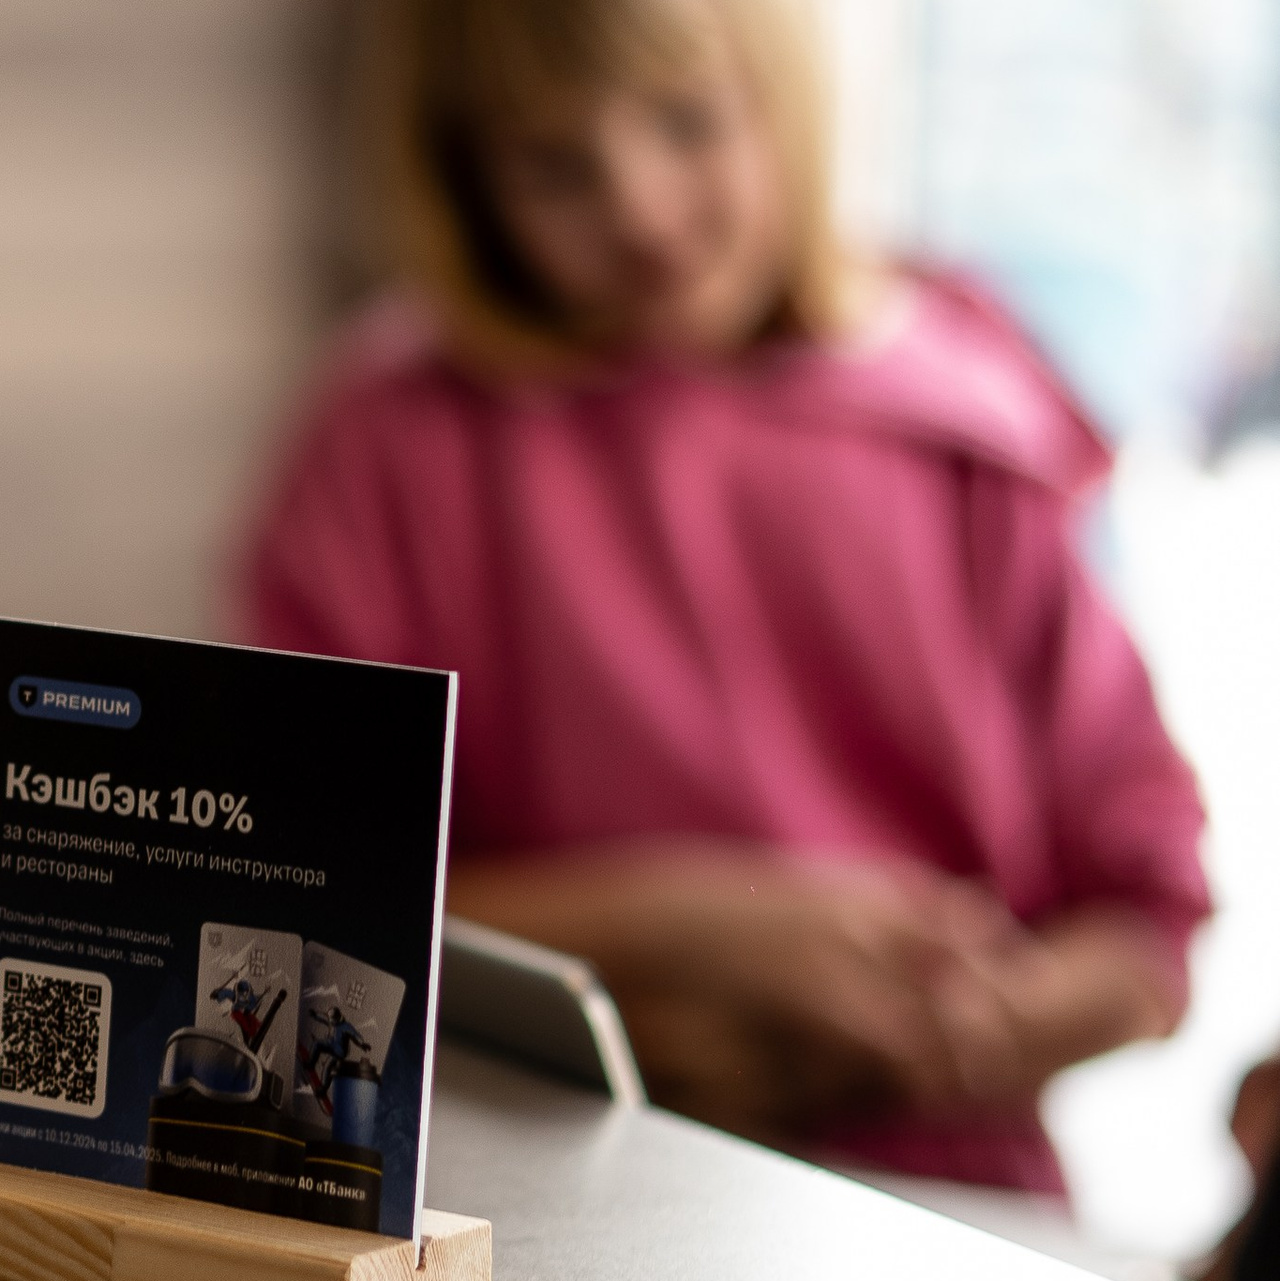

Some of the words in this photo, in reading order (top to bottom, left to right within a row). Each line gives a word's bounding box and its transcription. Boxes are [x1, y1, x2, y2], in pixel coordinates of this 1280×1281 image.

[42, 690, 131, 717] PREMIUM
[5, 762, 160, 820] Кэшбэк
[168, 786, 253, 834] 10%
[0, 852, 13, 869] и
[16, 854, 113, 885] рестораны
[2, 823, 22, 841] за
[26, 826, 140, 861] снаряжение,
[145, 845, 205, 870] услуги
[208, 852, 326, 888] инструктора
[47, 917, 104, 937] перечень
[106, 926, 174, 949] заведений,
[77, 943, 84, 955] в
[87, 944, 127, 962] акции,
[130, 951, 165, 969] здесь
[12, 1122, 37, 1139] акции
[45, 1127, 96, 1150] 10.12.2024
[98, 1139, 108, 1152] по
[166, 1150, 212, 1171] Подробнее
[214, 1162, 219, 1172] в
[221, 1161, 240, 1177] моб.
[242, 1166, 296, 1189] приложении
[298, 1175, 314, 1191] АО
[316, 1179, 367, 1201] «ТБанк»
